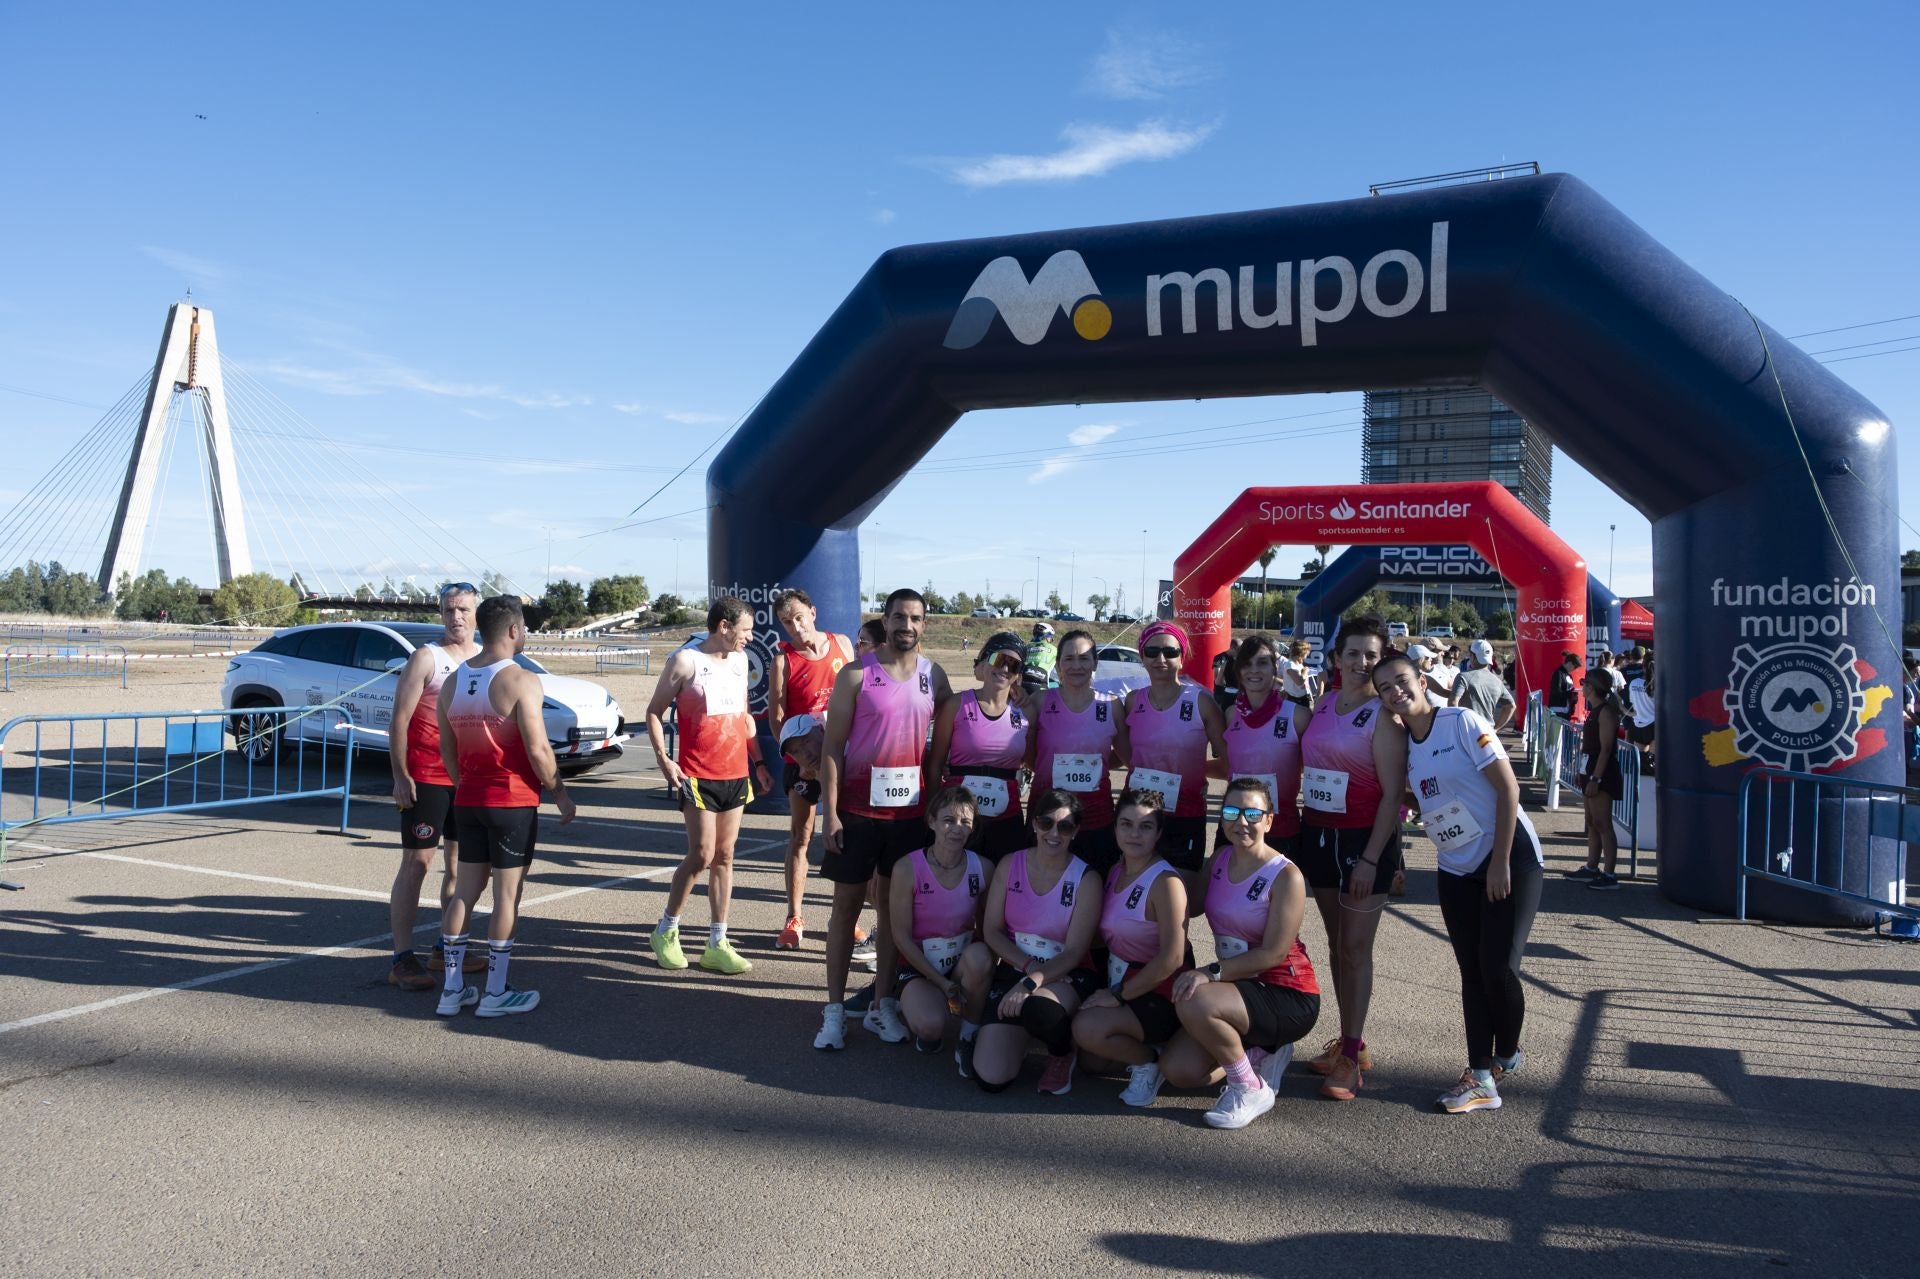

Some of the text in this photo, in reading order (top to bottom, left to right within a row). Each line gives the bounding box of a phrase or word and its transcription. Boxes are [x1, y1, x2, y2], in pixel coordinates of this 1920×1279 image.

[1145, 220, 1450, 347] mupol
[1258, 500, 1471, 525] Sports Santander
[1318, 525, 1405, 536] sportssantander.es
[1380, 547, 1483, 561] POLICI
[710, 579, 796, 604] fundació
[1711, 576, 1876, 606] fundación
[1181, 596, 1210, 607] Sports
[1534, 598, 1571, 611] Sports
[1180, 609, 1225, 619] Santander
[1530, 613, 1584, 623] Santander
[1303, 621, 1325, 635] RUTA
[1740, 607, 1848, 642] mupol
[1748, 660, 1845, 709] Fundación de la Mutualidad de la
[1771, 731, 1823, 746] POLICÍA
[1065, 772, 1092, 783] 1086
[885, 787, 910, 798] 1089
[1309, 788, 1332, 802] 1093
[974, 794, 997, 808] 091
[1437, 824, 1464, 842] 2162
